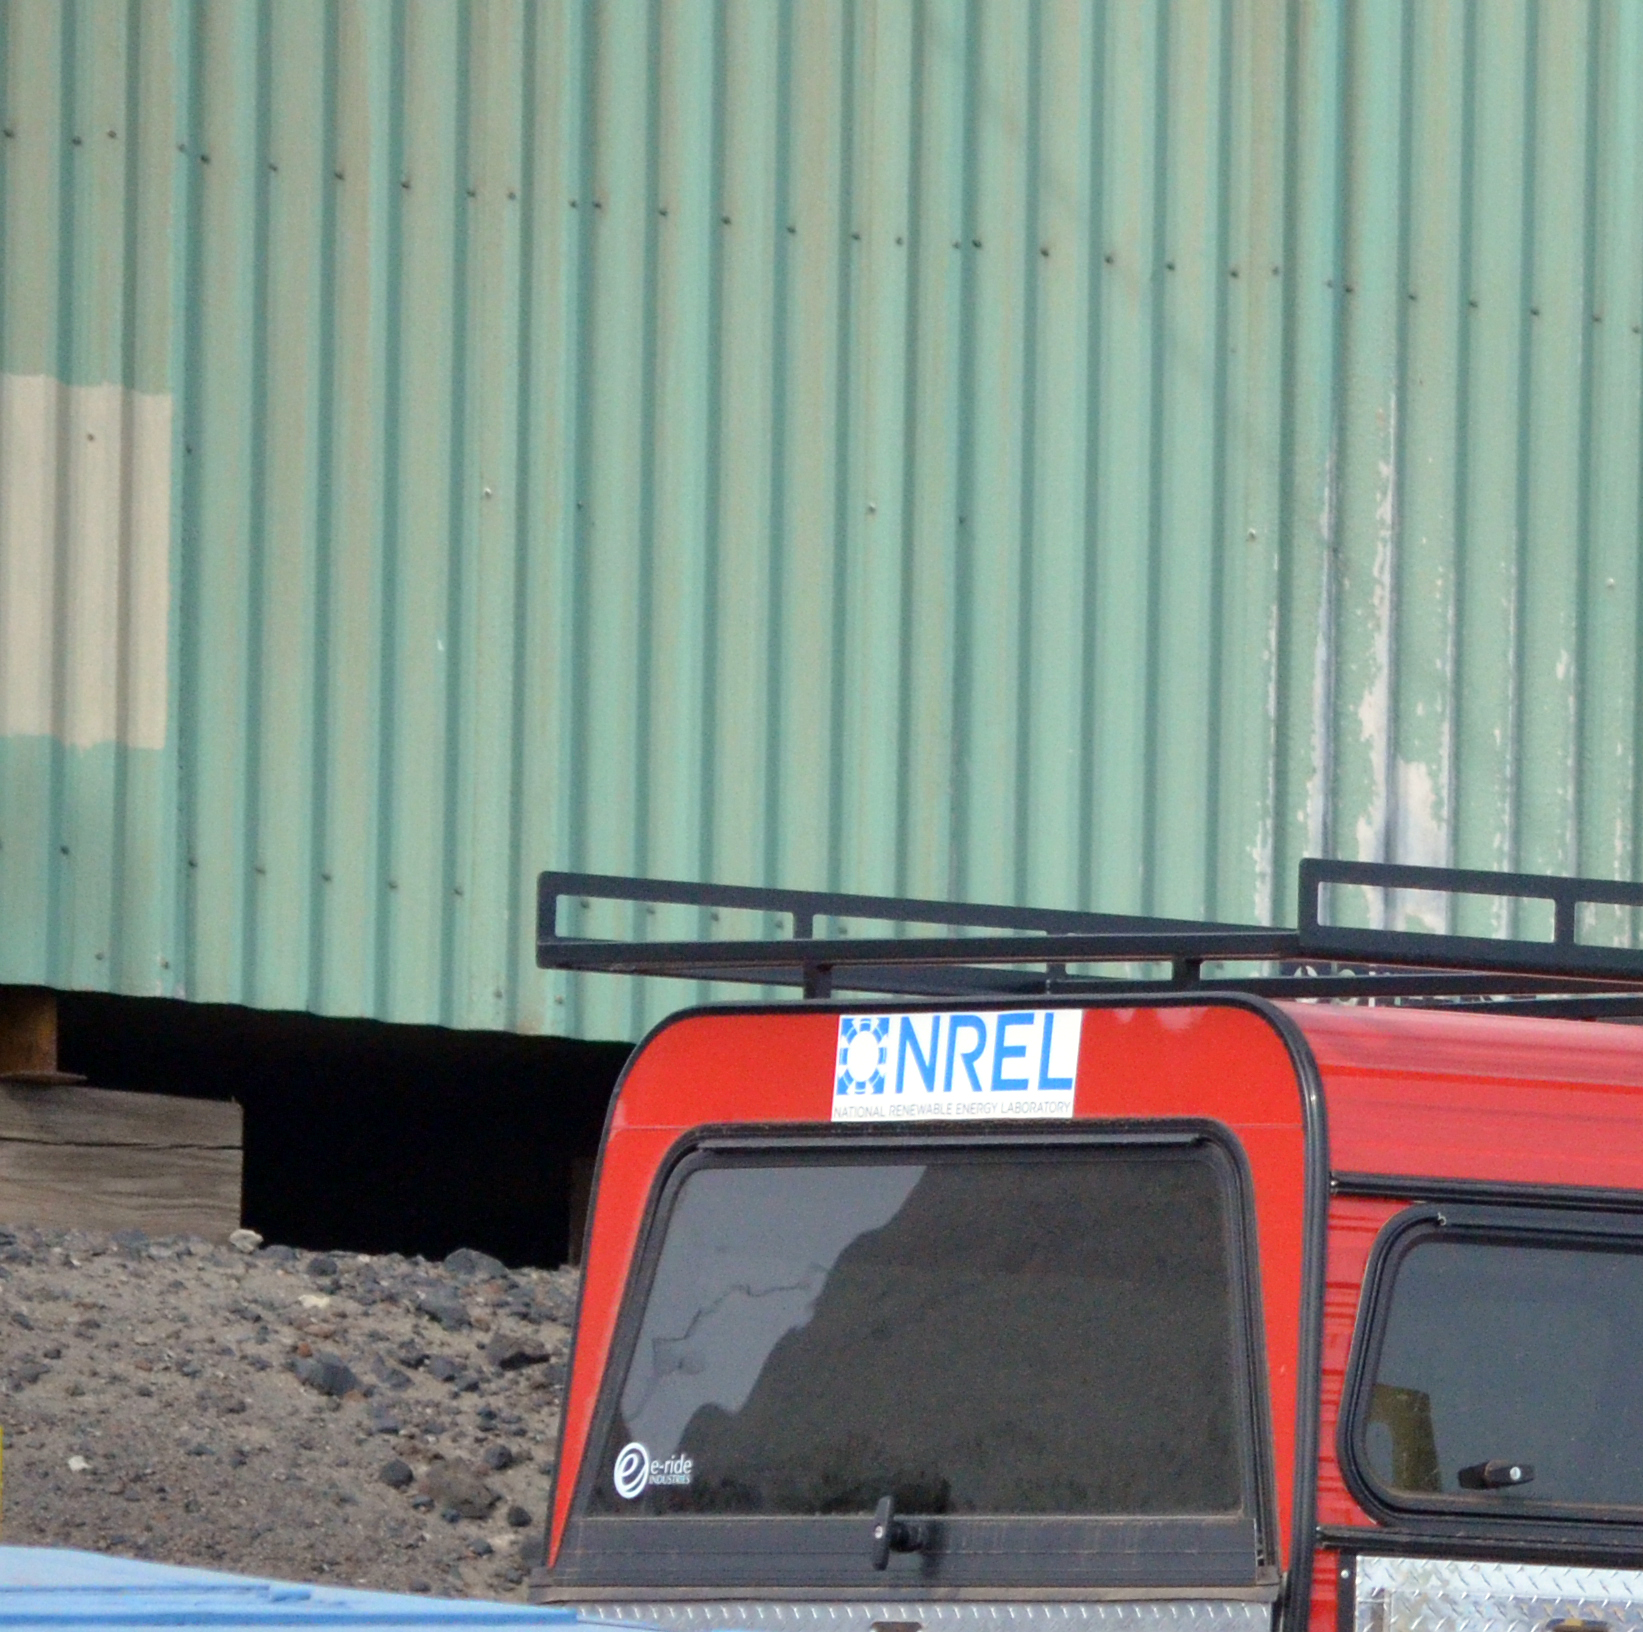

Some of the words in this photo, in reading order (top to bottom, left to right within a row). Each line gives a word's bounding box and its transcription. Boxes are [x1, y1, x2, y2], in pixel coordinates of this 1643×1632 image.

[895, 1012, 1073, 1094] NREL
[834, 1106, 886, 1118] NATIONAL
[889, 1103, 952, 1116] RENEWABLE
[956, 1102, 998, 1115] ENERGY
[1001, 1100, 1071, 1114] LABORATORY
[650, 1453, 693, 1475] e-ride
